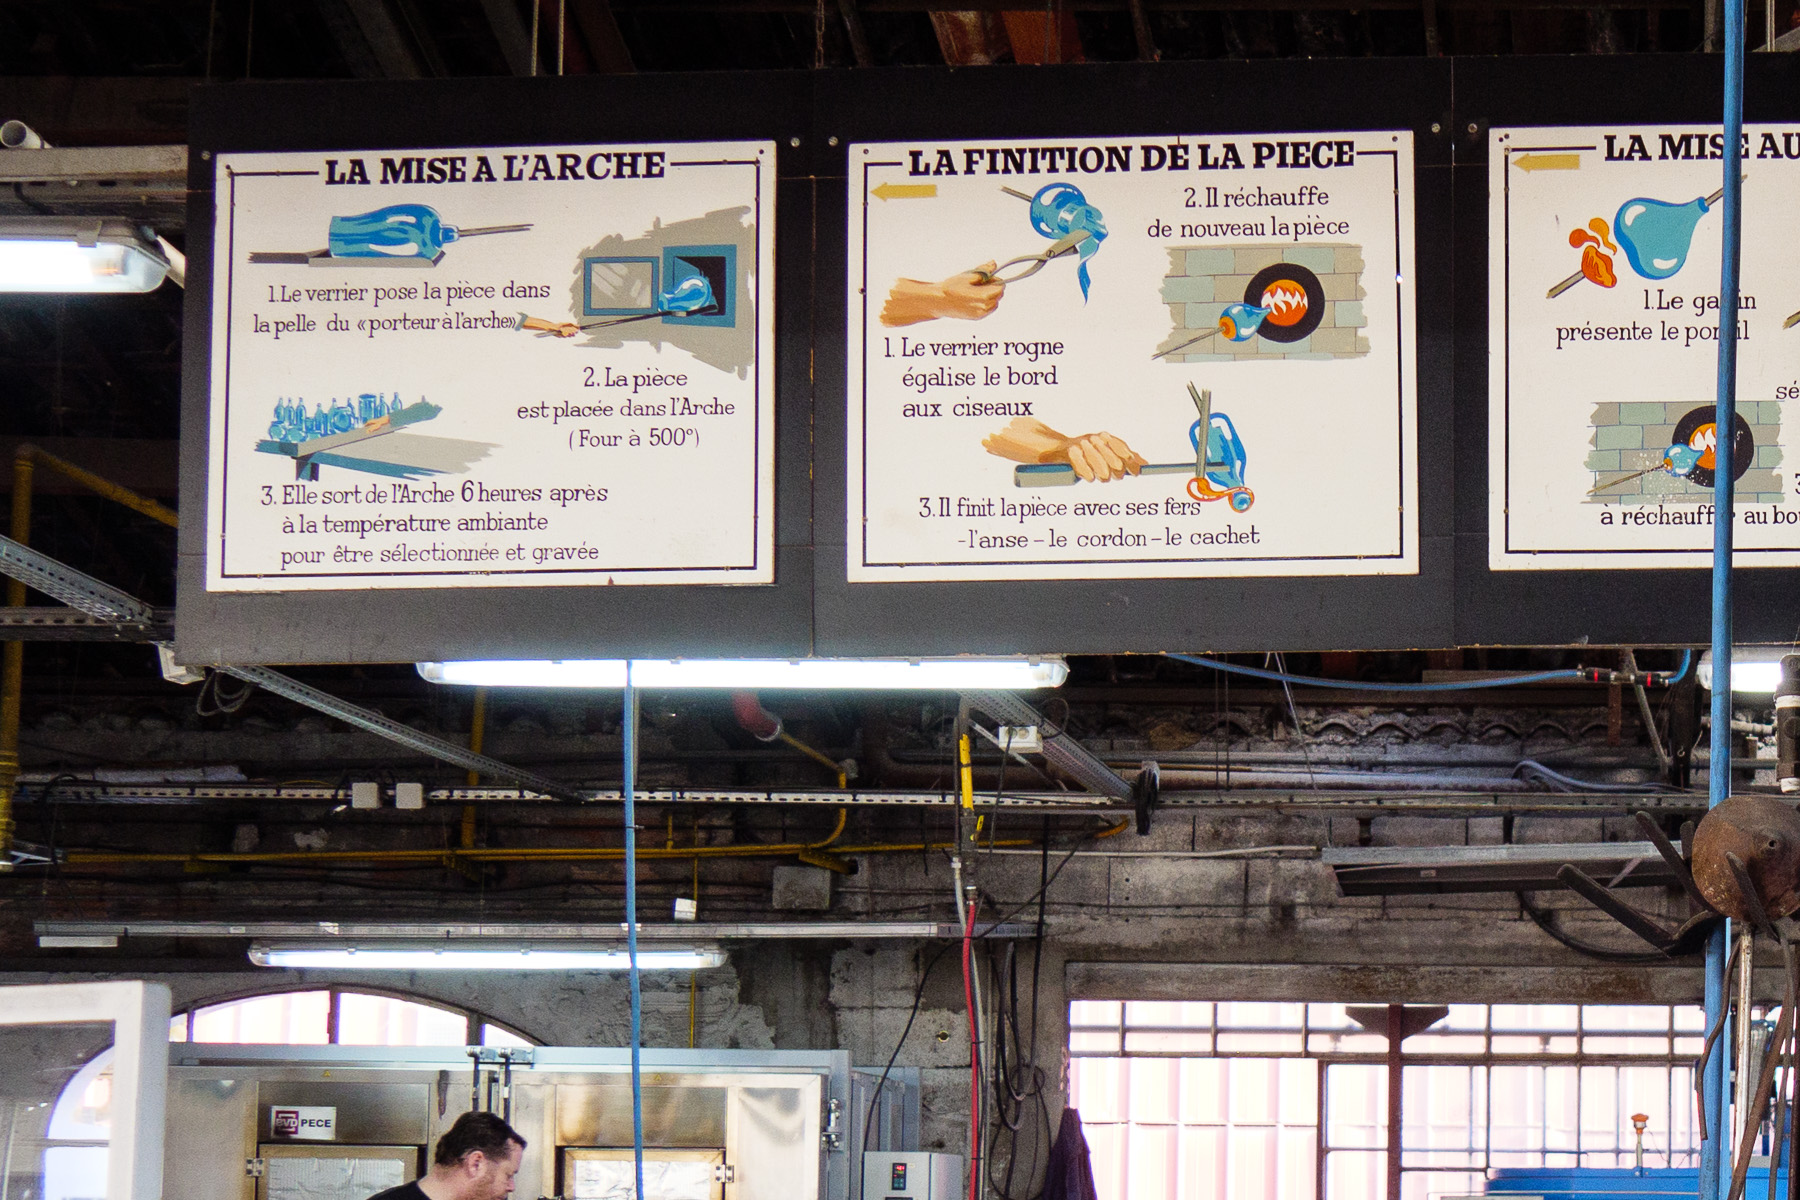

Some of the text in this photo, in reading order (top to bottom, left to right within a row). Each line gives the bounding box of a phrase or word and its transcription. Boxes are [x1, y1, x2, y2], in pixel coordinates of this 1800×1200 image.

[908, 140, 1354, 177] LA FINITION DE LA PIECE
[1604, 134, 1652, 162] LA
[325, 152, 665, 185] LA MISE A L'ARCHE
[1206, 185, 1329, 208] Il réchauffe
[1147, 215, 1349, 242] de nouveau pièce
[305, 280, 550, 308] verrier pose la pièce dans
[1692, 287, 1757, 317] gain
[254, 313, 350, 340] la pelle du
[1556, 320, 1679, 350] présente le
[901, 335, 1064, 362] Le verrier rogne
[605, 367, 688, 394] La pièce
[902, 365, 1058, 393] égalise le bord
[517, 397, 735, 425] est placée dans l'Arche
[903, 396, 1033, 418] aux ciseaux
[629, 429, 640, 446] à
[282, 480, 608, 508] Elle sort de l'Arche 6 heures après
[939, 496, 1201, 524] Il finit pièce avec ses fers
[1600, 503, 1768, 525] à au
[282, 512, 548, 539] à la température ambiante
[1049, 524, 1260, 547] le cordon le cachet
[281, 543, 599, 571] pour être sélectionnée et gravée
[301, 1119, 331, 1128] PECE
